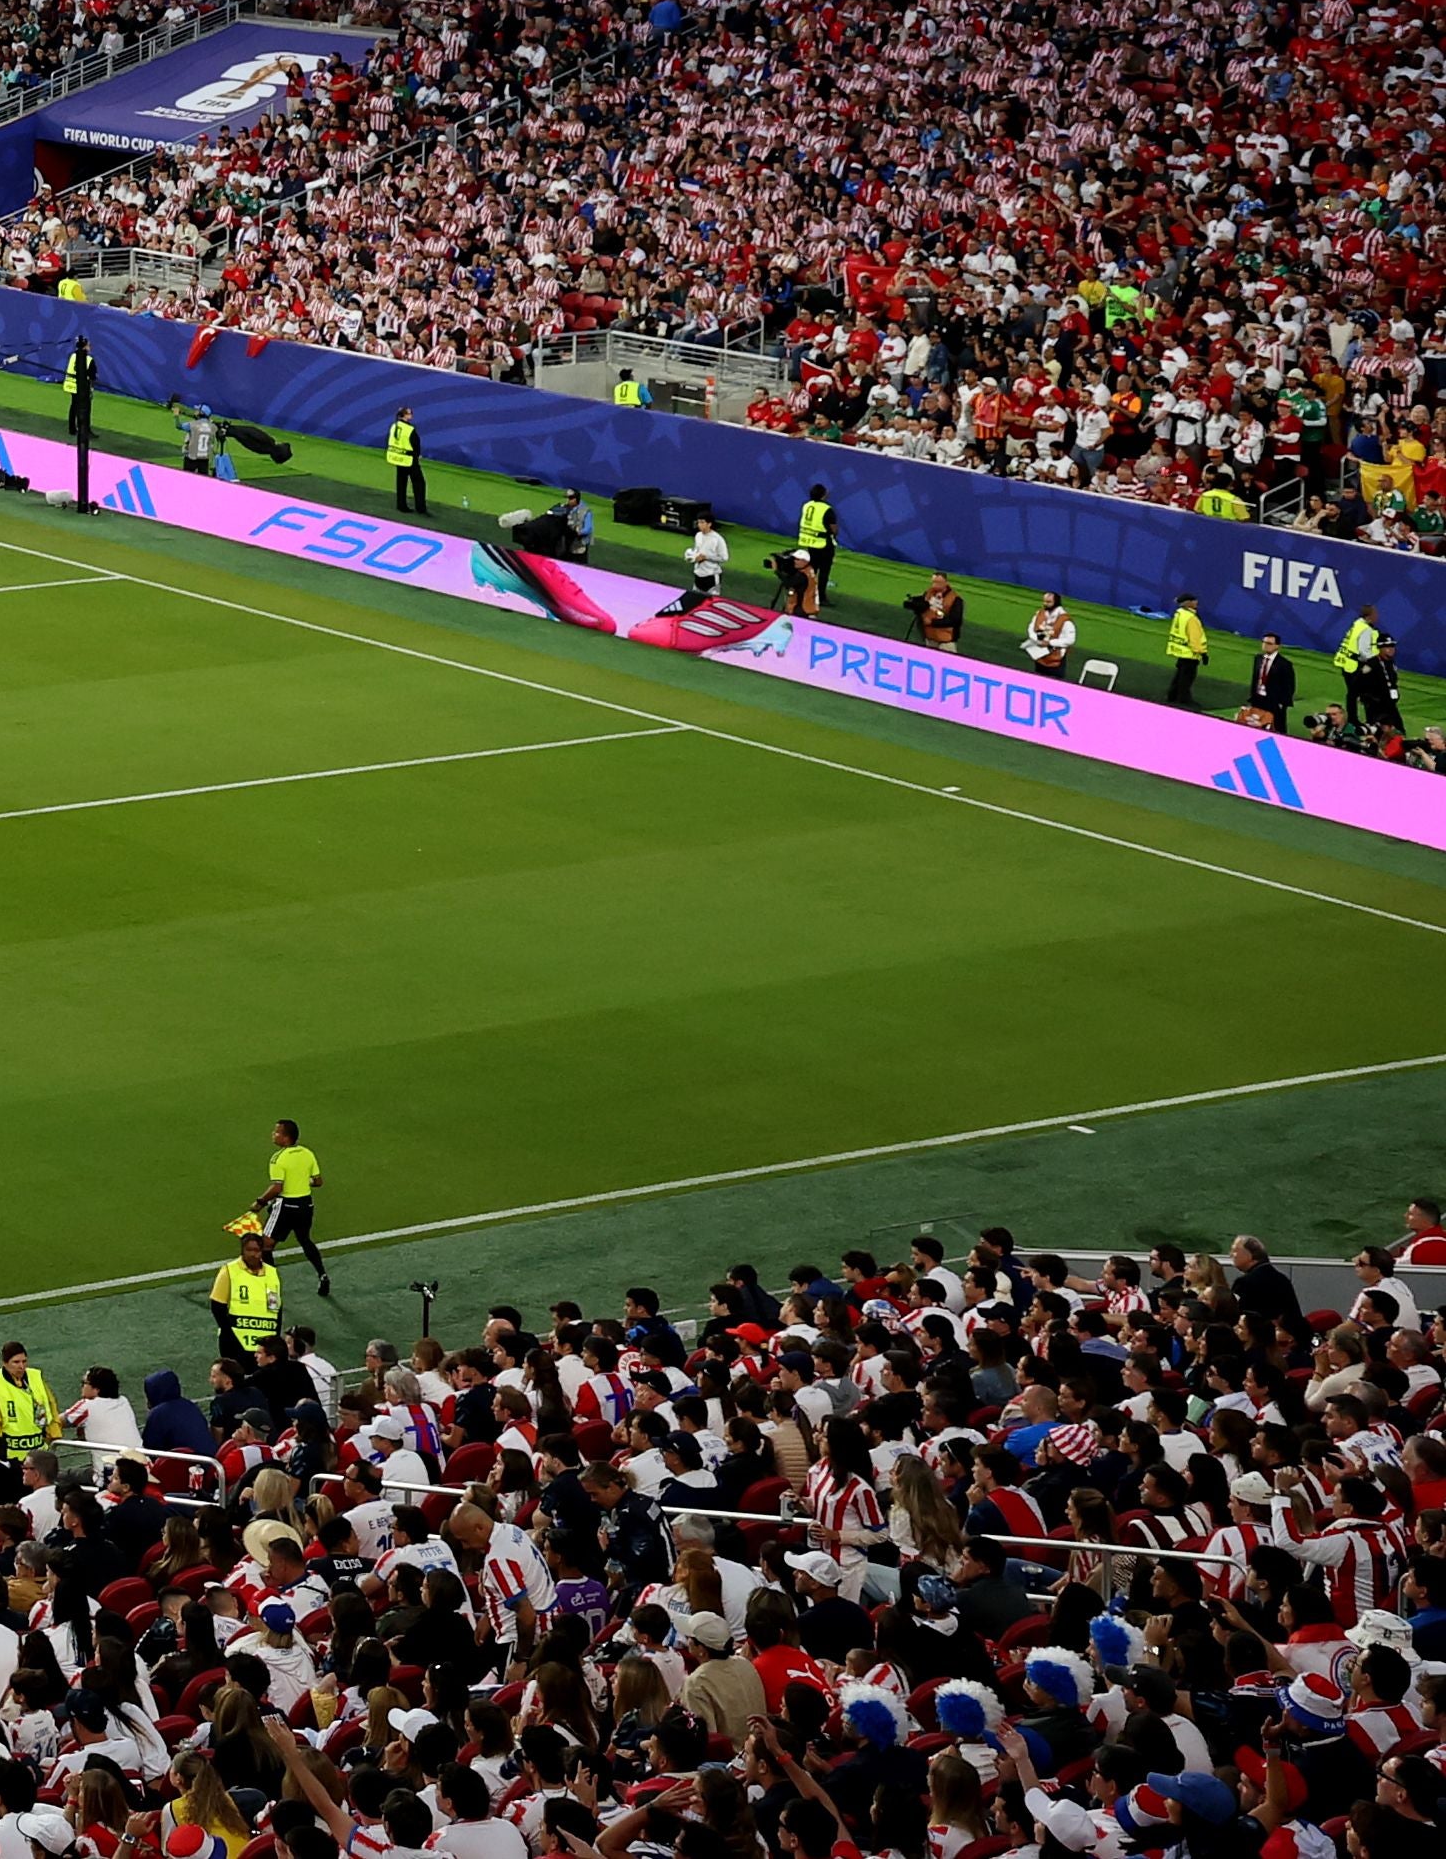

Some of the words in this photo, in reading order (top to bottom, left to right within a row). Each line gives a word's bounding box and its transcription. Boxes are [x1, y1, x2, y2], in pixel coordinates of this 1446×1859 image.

[64, 128, 88, 144] FIFA
[89, 130, 130, 149] WORLD
[131, 137, 154, 152] CUP
[250, 507, 444, 574] F50
[1244, 552, 1343, 607] FIFA
[810, 635, 1071, 735] PREDATOR
[235, 1317, 279, 1330] SECURITY
